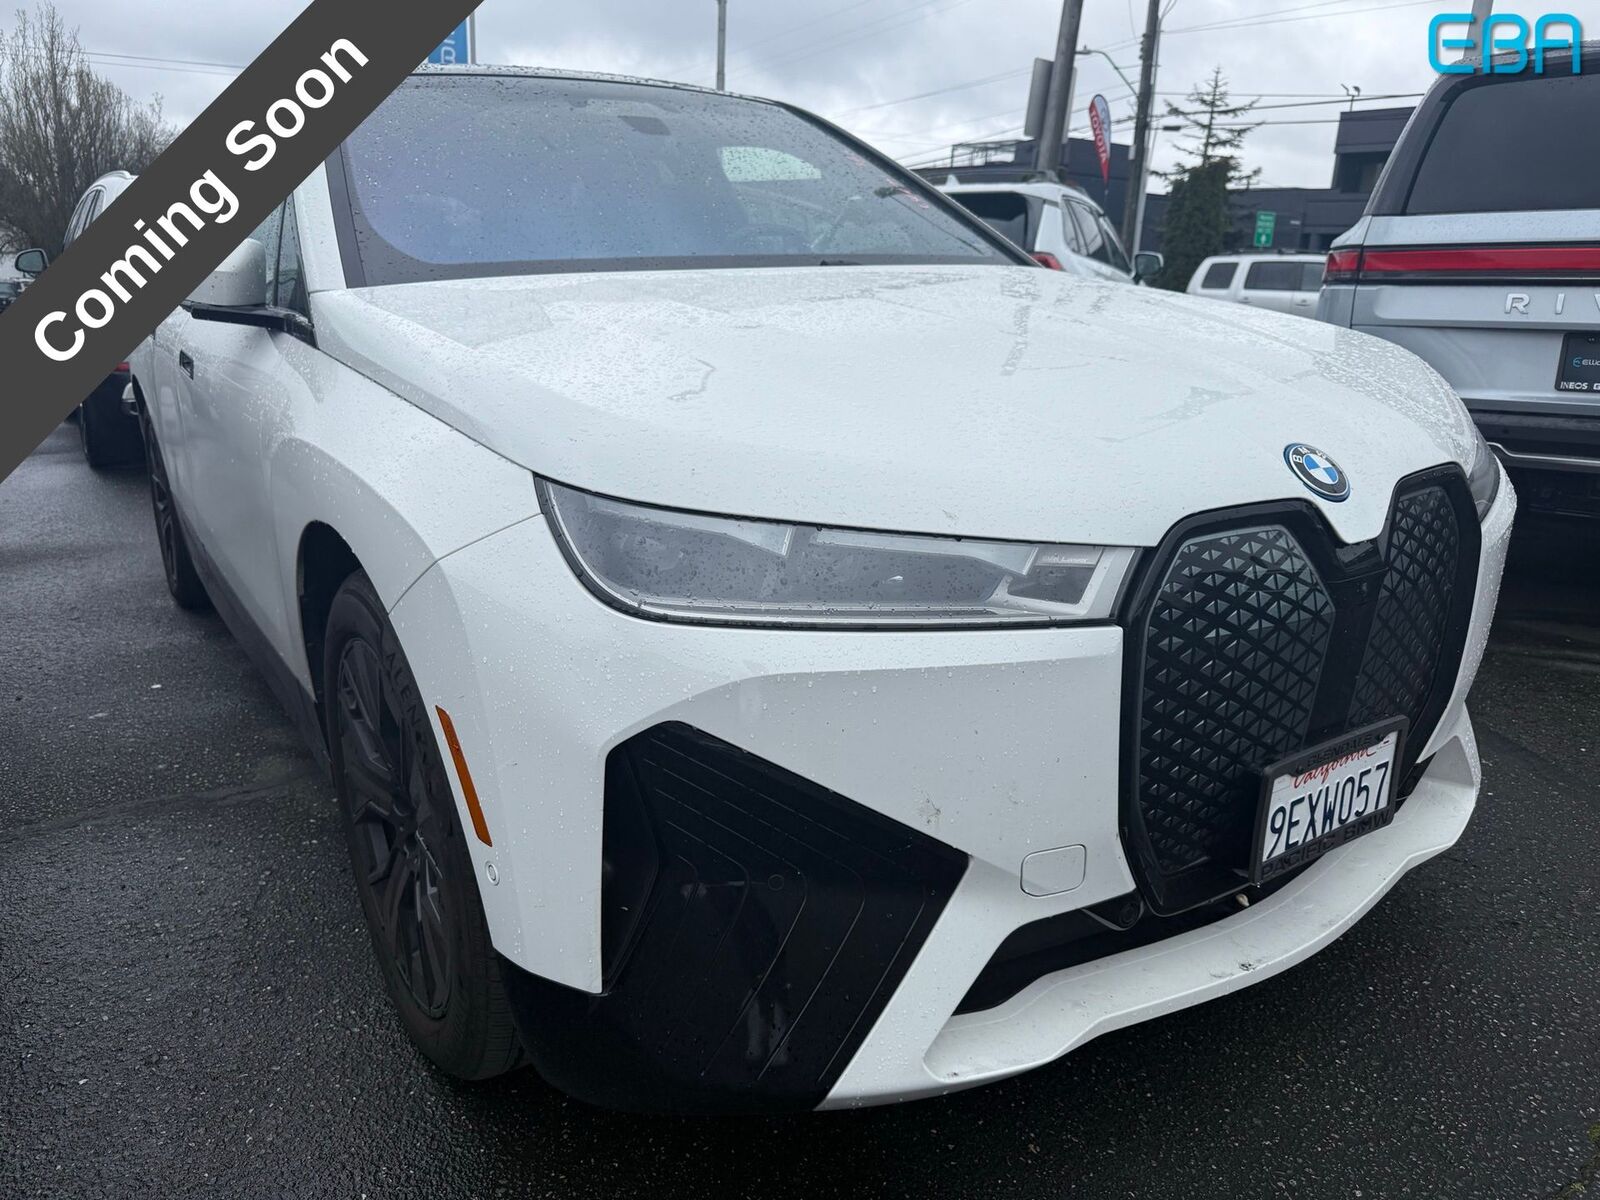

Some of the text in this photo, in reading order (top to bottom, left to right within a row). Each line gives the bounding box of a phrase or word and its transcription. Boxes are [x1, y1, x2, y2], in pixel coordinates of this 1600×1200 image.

[1091, 109, 1107, 163] TOYOTA
[1560, 381, 1588, 390] INEOS
[1292, 446, 1326, 463] BMW
[1266, 760, 1390, 860] 9EXW057
[1262, 809, 1391, 876] PACIFIC BMW
